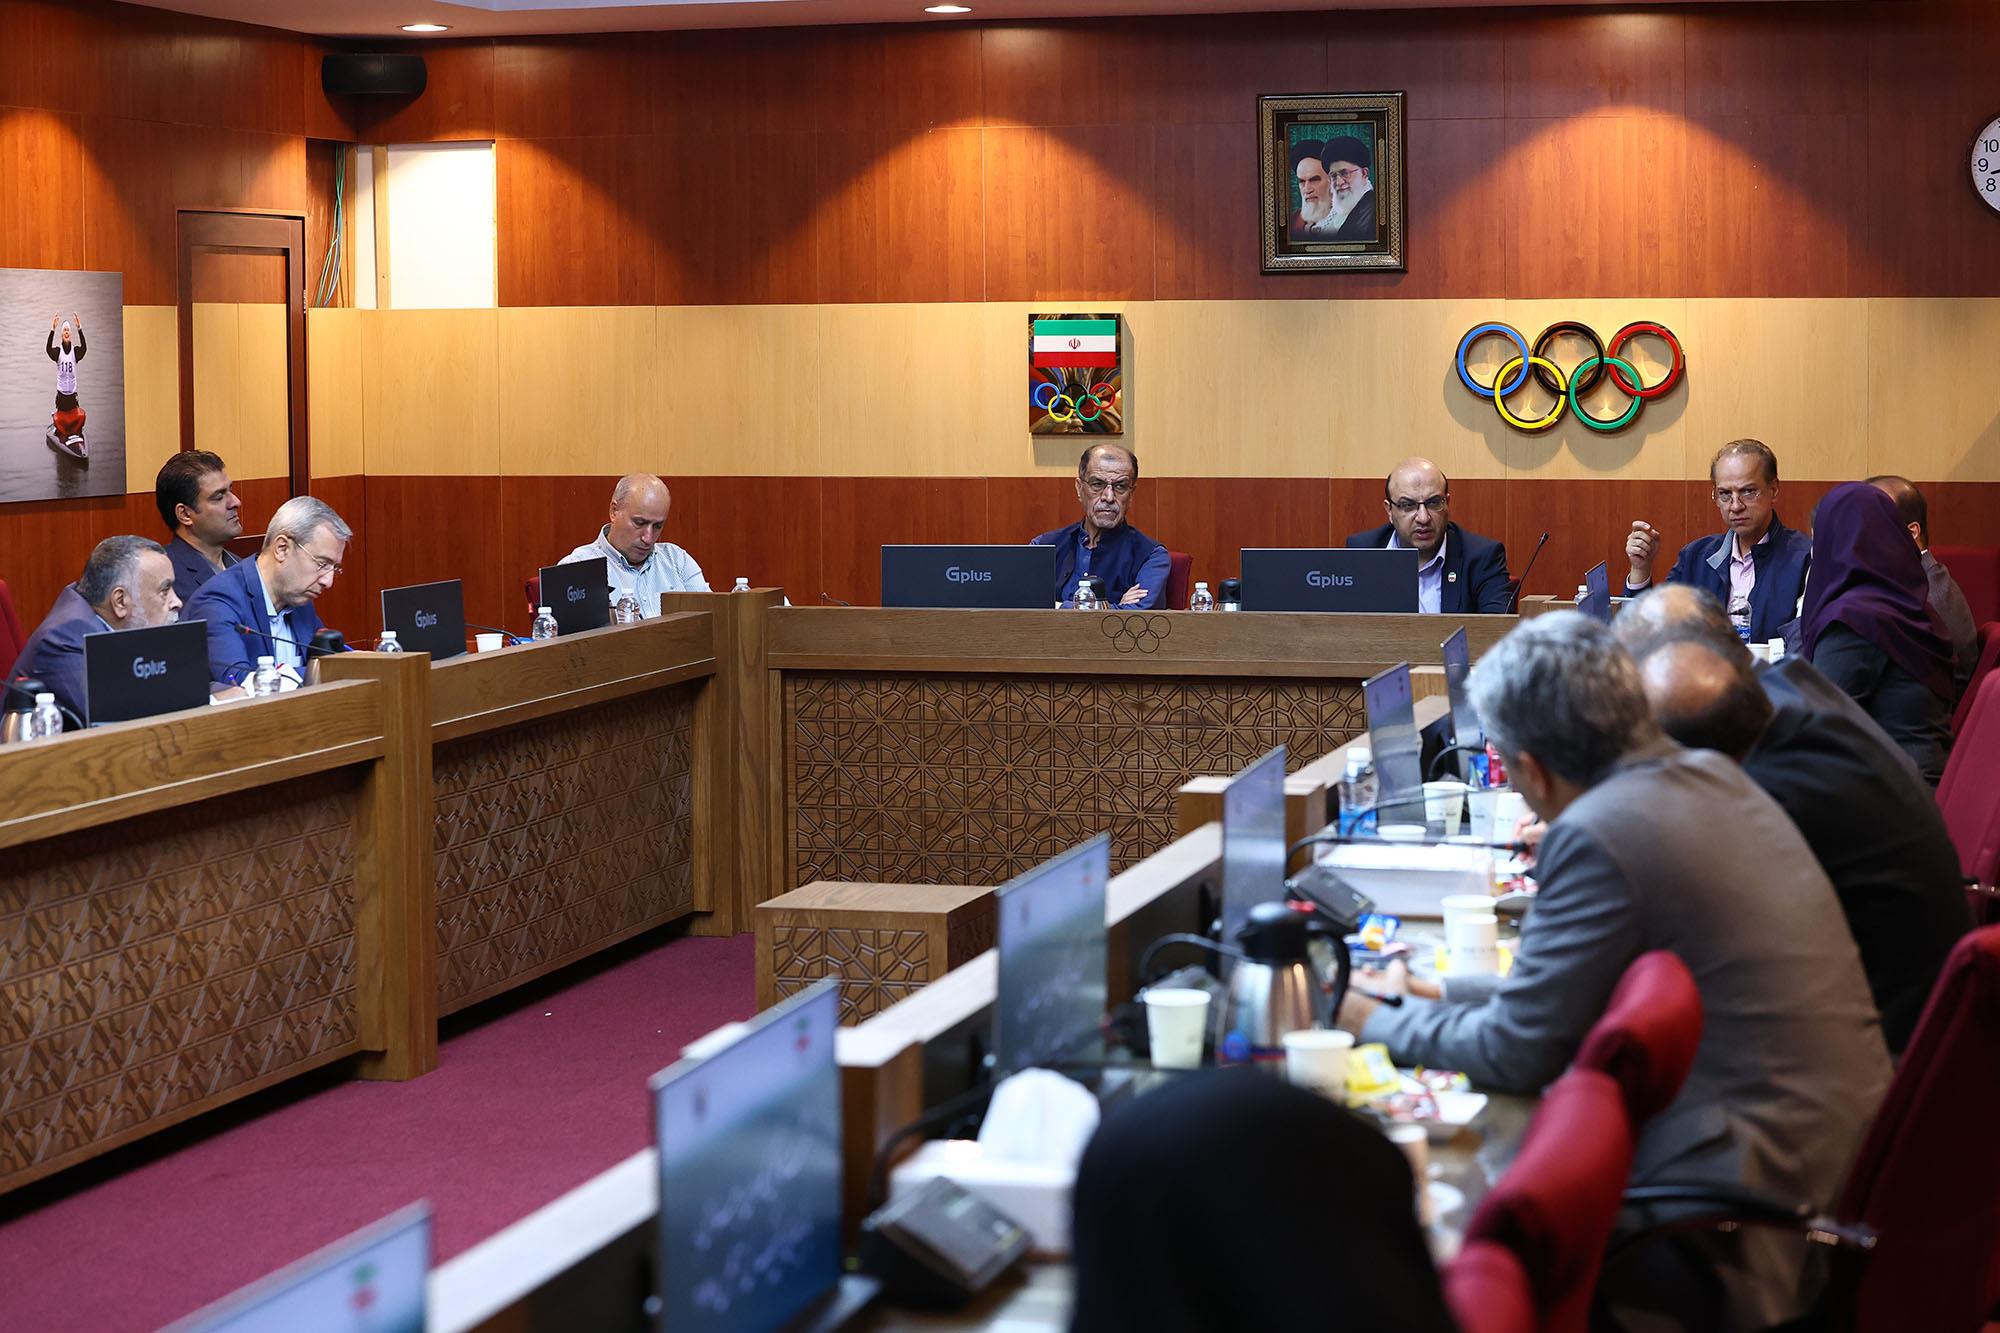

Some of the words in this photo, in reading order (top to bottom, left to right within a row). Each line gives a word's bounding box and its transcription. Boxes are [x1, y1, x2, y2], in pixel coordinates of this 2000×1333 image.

[1983, 139, 1999, 152] 10
[1978, 158, 1988, 172] 9
[1986, 178, 1996, 192] 8
[61, 361, 73, 373] 118
[945, 566, 992, 584] Gplus
[1306, 570, 1353, 588] Gplus
[567, 585, 586, 604] Gplus
[415, 610, 437, 629] Gplus
[132, 656, 167, 680] Gplus
